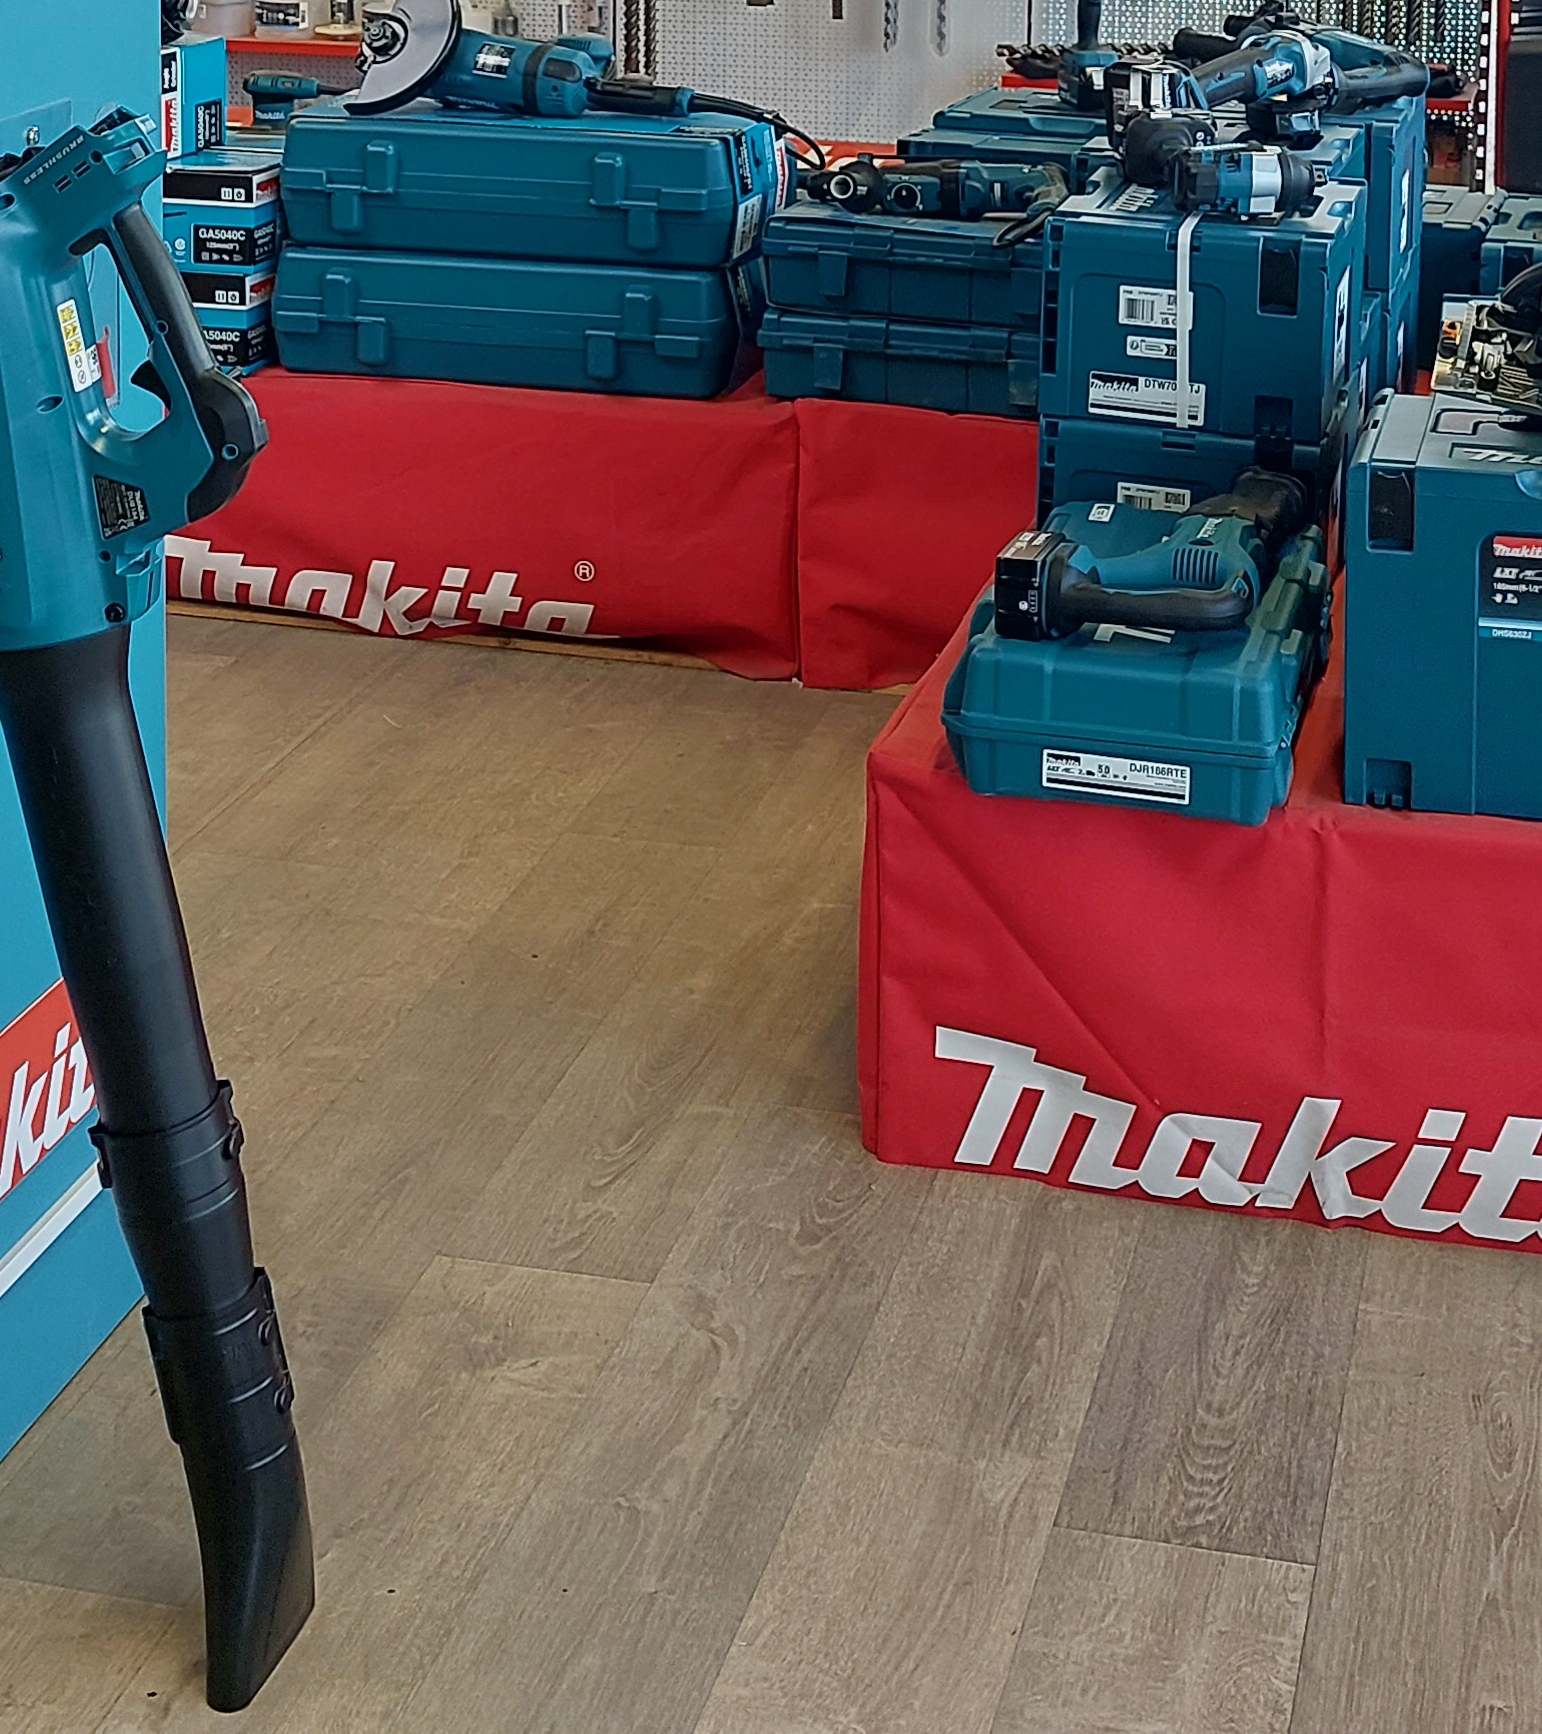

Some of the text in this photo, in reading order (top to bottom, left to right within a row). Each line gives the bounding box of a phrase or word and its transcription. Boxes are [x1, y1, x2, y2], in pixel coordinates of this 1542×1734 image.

[199, 228, 246, 241] GA5040C
[204, 330, 240, 342] 5040C
[1091, 378, 1200, 394] Makita DTW70TJ
